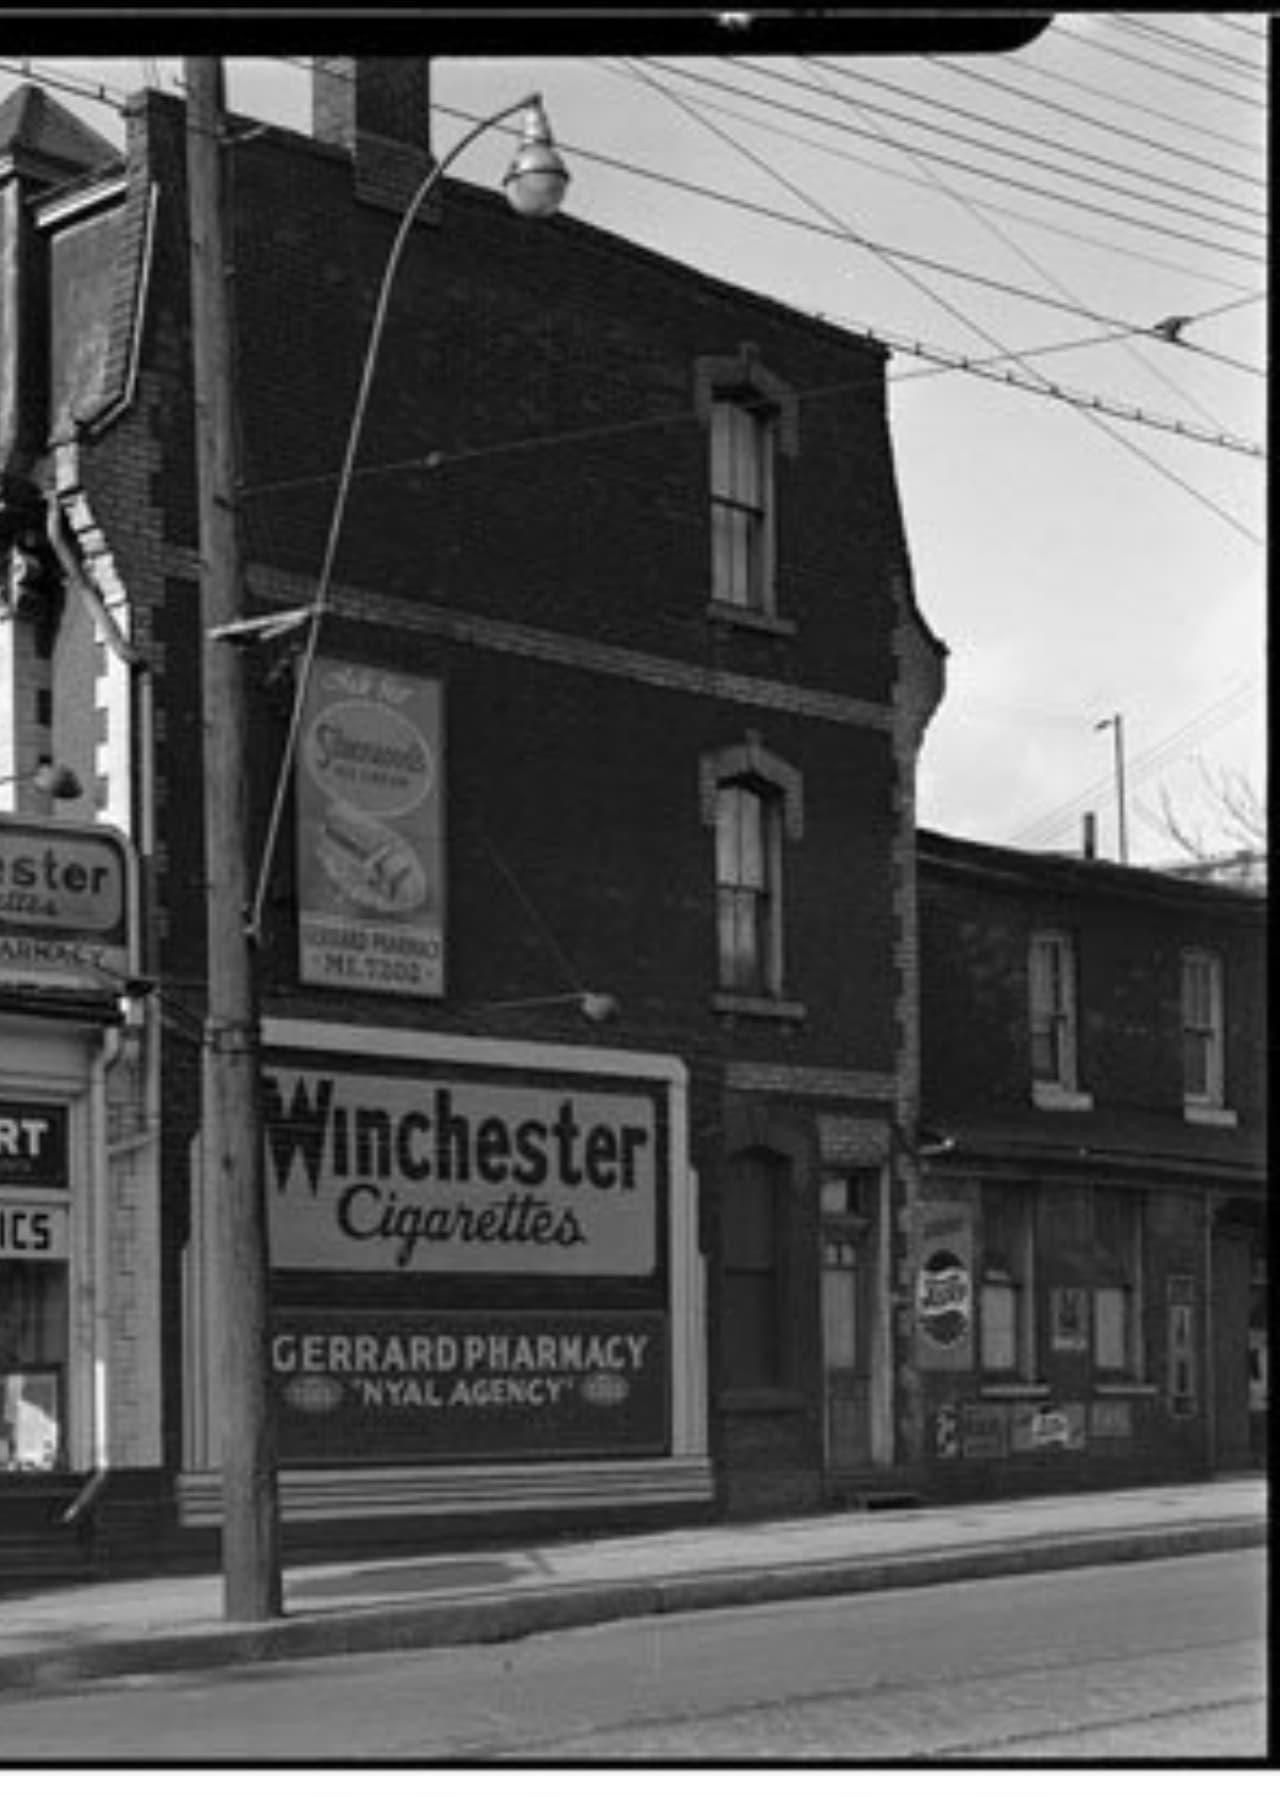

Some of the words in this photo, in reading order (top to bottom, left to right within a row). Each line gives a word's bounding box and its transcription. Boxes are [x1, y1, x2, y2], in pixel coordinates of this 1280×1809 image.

[261, 1075, 649, 1199] Winchester
[336, 1183, 587, 1268] Cigarettes
[272, 1334, 458, 1373] GERRARD
[465, 1333, 650, 1372] PHARMACY
